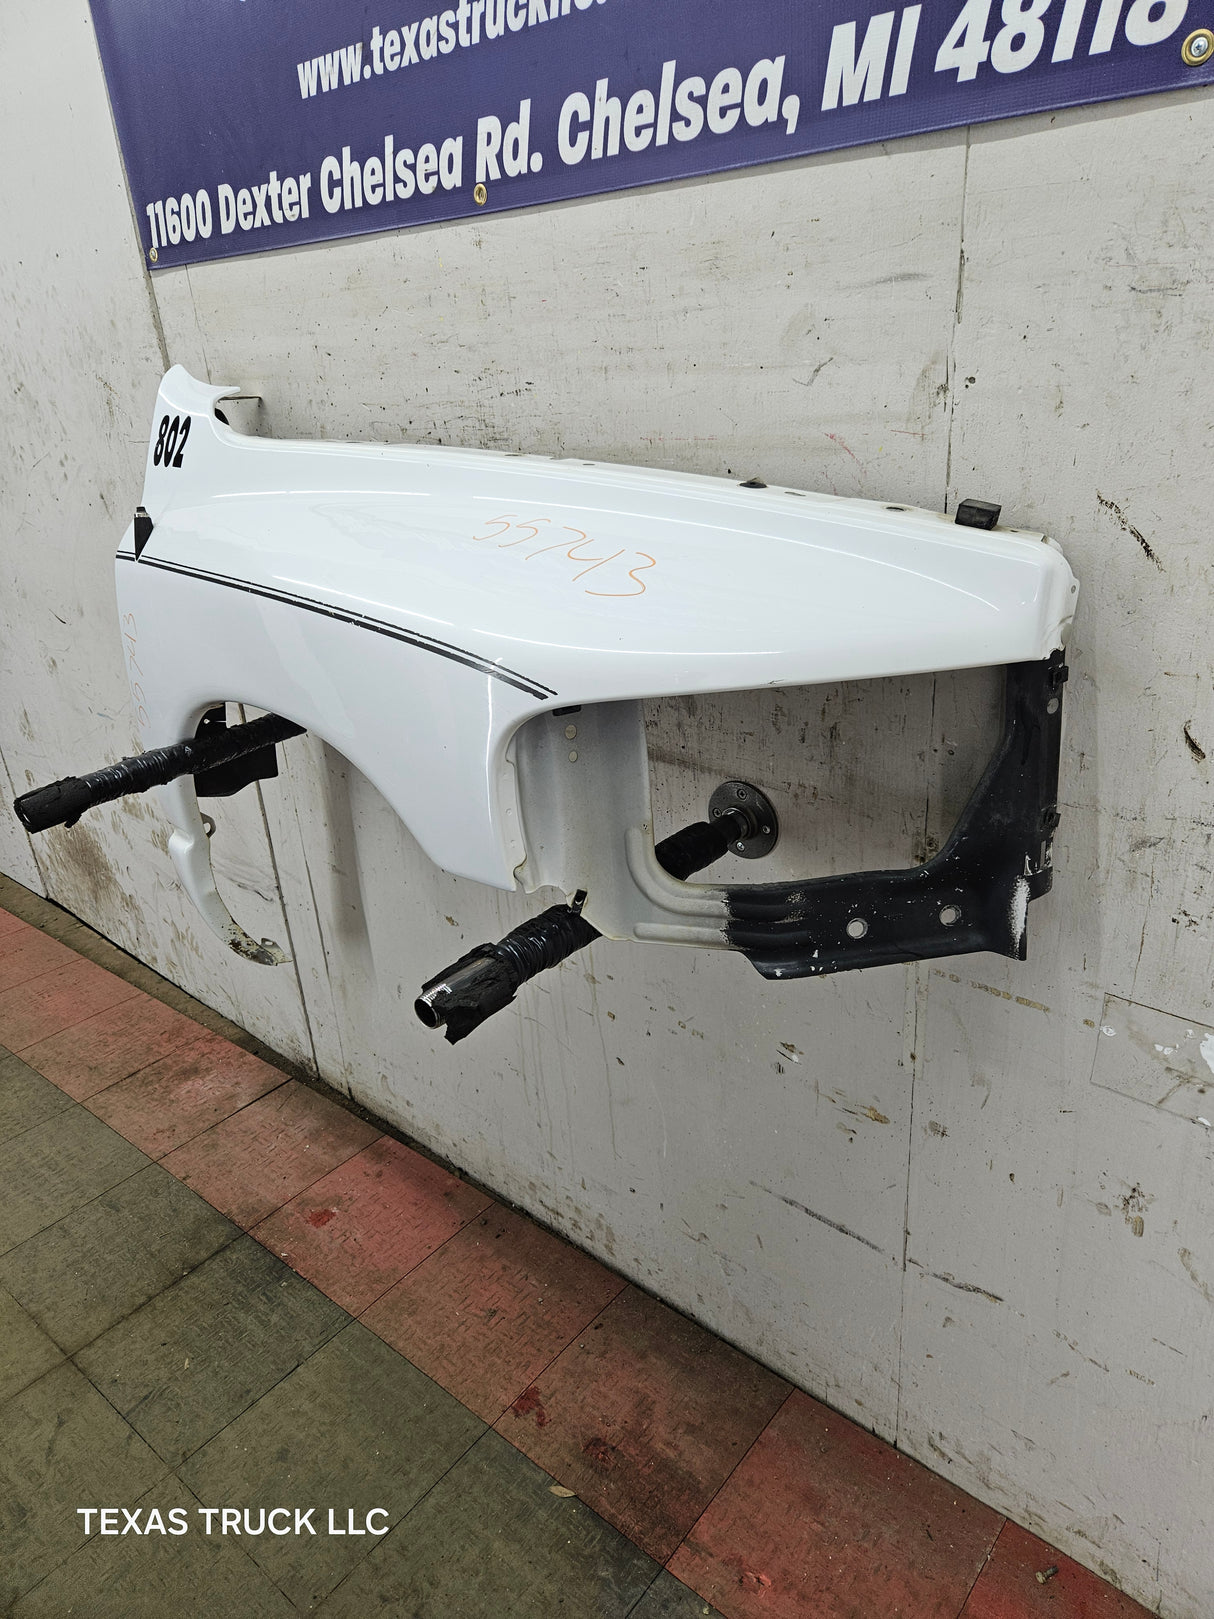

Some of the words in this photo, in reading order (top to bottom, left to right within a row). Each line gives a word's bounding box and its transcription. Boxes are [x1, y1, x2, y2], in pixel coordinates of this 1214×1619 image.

[147, 188, 212, 249] 11600
[218, 168, 311, 235] Dexter
[320, 135, 463, 213] Chelsea
[475, 99, 543, 184] Rd.
[558, 55, 801, 165] Chelsea,
[821, 4, 922, 112] MI
[153, 414, 192, 469] 802
